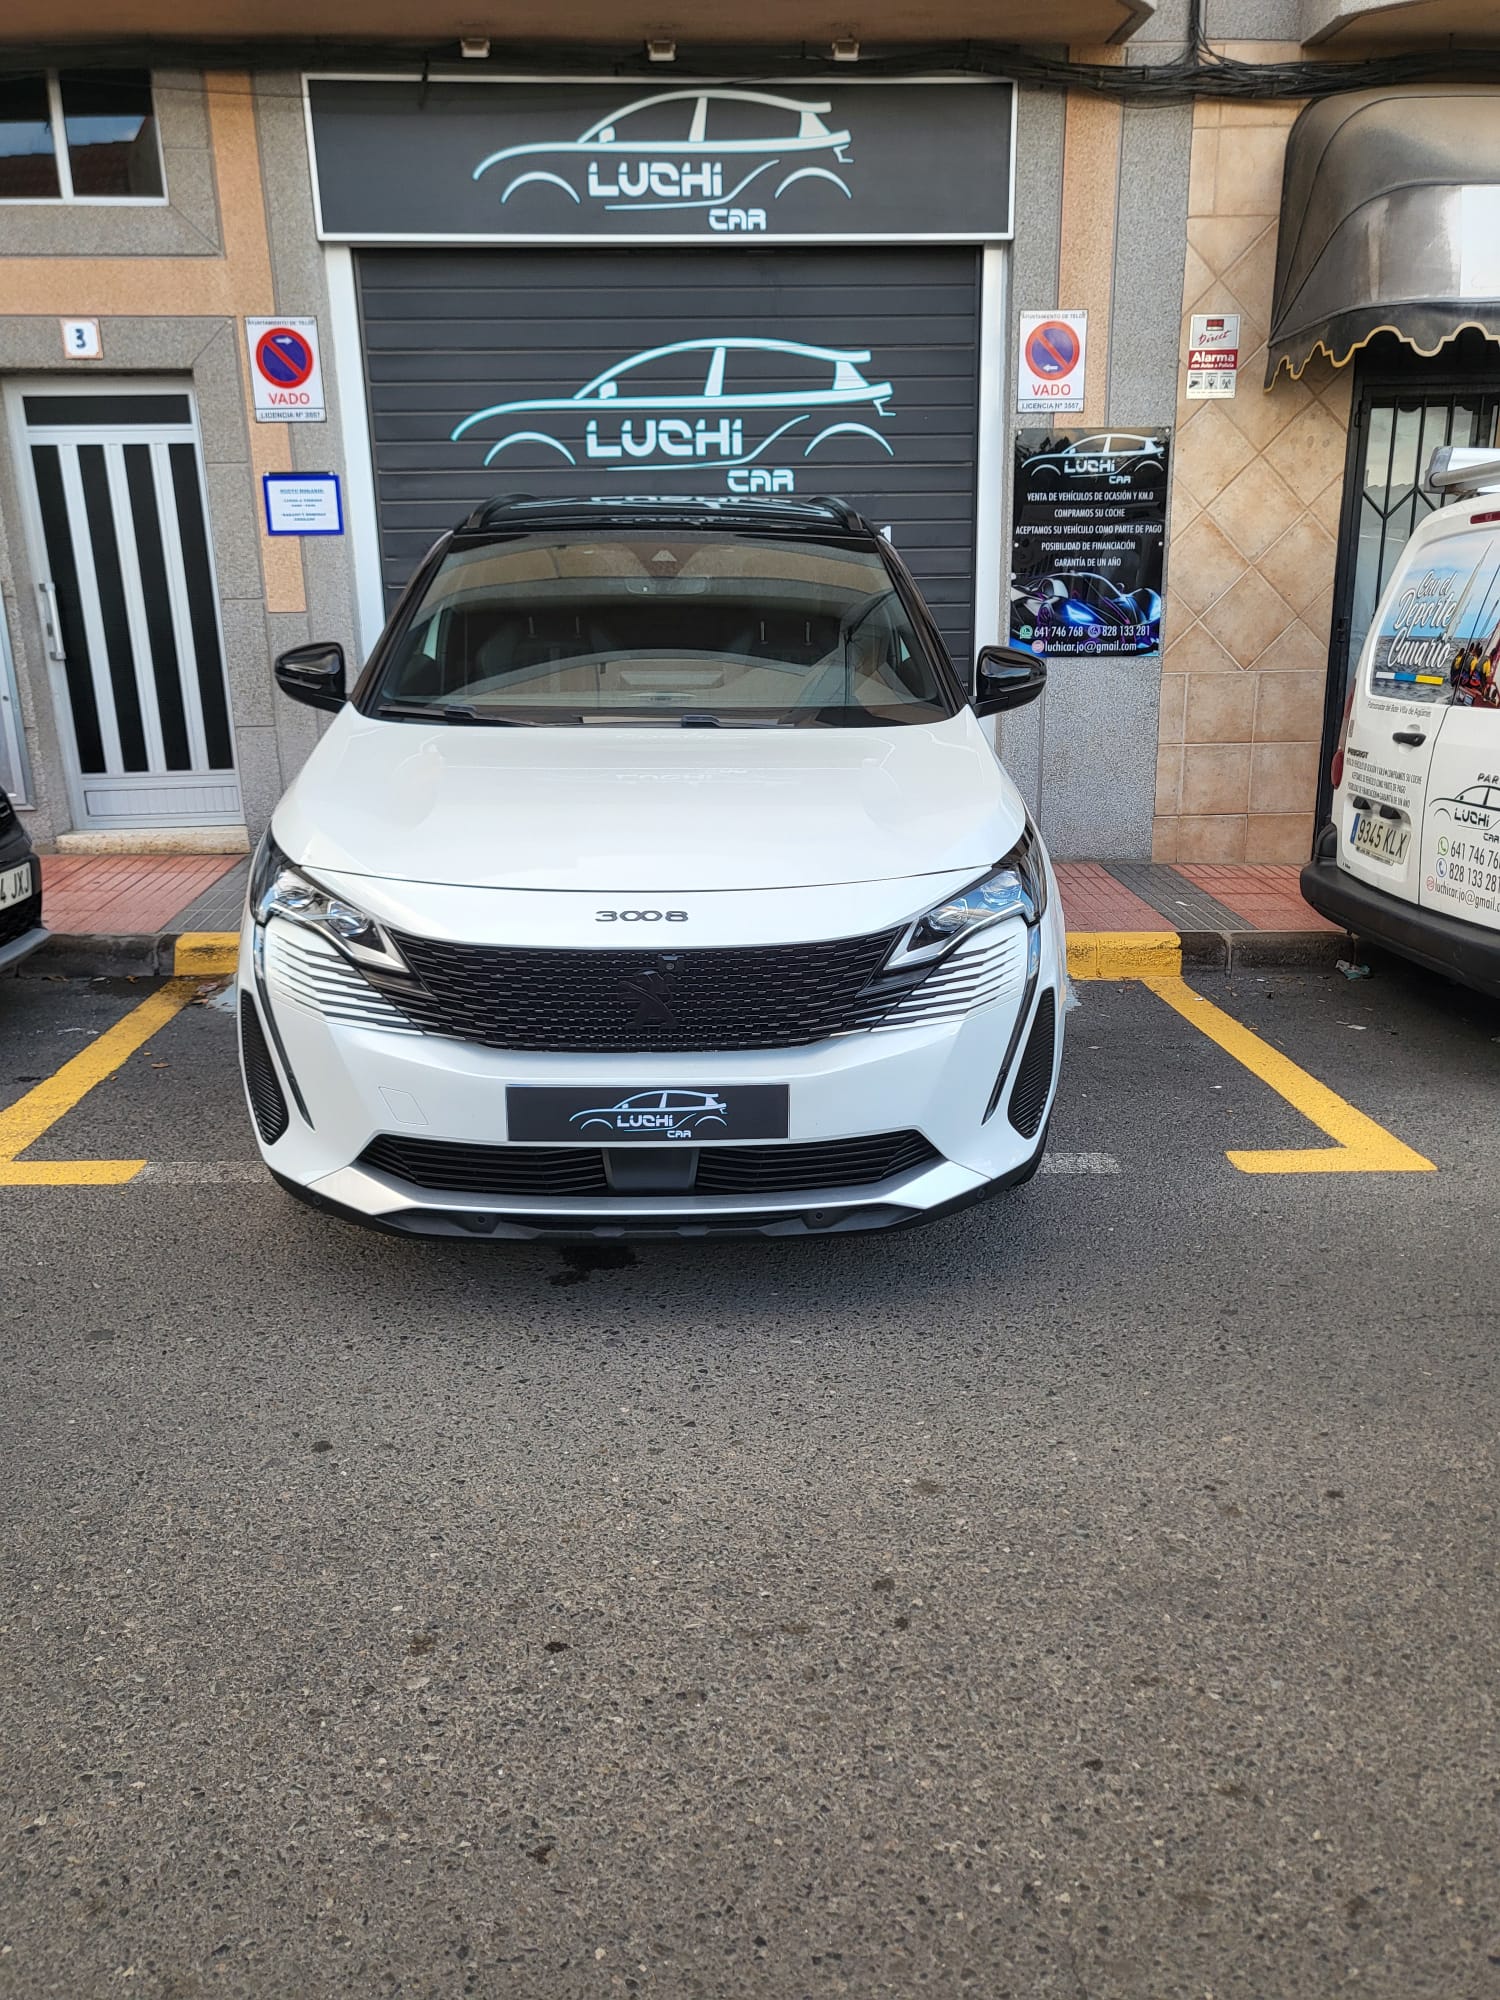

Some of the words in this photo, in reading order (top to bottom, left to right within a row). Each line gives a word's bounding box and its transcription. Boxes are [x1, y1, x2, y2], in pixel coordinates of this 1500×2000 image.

[587, 161, 722, 197] LUCHI
[708, 208, 767, 231] CAR
[75, 328, 86, 349] 3
[1198, 329, 1232, 346] Direct
[1191, 351, 1235, 363] Alarma
[1031, 383, 1071, 396] VADO
[268, 392, 311, 405] VADO
[1021, 402, 1055, 410] LICENCIA
[260, 411, 293, 419] LICENCIA
[586, 418, 743, 457] LUCHI
[1064, 459, 1116, 473] LUCHI
[727, 468, 794, 492] CAR
[1108, 475, 1132, 484] CAR
[1027, 492, 1047, 502] VENTA
[1048, 492, 1058, 502] DE
[1059, 490, 1093, 502] VEHÍCULOS
[1094, 491, 1103, 501] DE
[1104, 489, 1132, 501] OCASIÓN
[1133, 491, 1138, 501] Y
[1054, 508, 1094, 518] COMPRAMOS
[1095, 508, 1104, 518] SU
[1104, 508, 1126, 518] COCHE
[1015, 525, 1052, 535] ACEPTAMOS
[1053, 525, 1062, 535] SU
[1063, 523, 1094, 535] VEHÍCULO
[1095, 525, 1114, 534] COMO
[1114, 524, 1134, 534] PARTE
[1135, 524, 1144, 534] DE
[1145, 524, 1163, 533] PAGO
[1041, 541, 1081, 551] POSIBILIDAD
[1082, 541, 1091, 551] DE
[1092, 539, 1136, 551] FINANCIACIÓN
[1054, 556, 1086, 567] GARANTÍA
[1087, 557, 1096, 567] DE
[1096, 557, 1107, 567] UN
[1107, 556, 1122, 567] AÑO
[1416, 569, 1440, 598] Con
[1439, 570, 1458, 596] el
[1393, 588, 1457, 638] Deporte
[1034, 625, 1049, 638] 641
[1051, 625, 1067, 637] 746
[1068, 625, 1084, 637] 768
[1102, 625, 1118, 637] 828
[1120, 625, 1134, 637] 133
[1135, 625, 1150, 637] 281
[1044, 640, 1137, 654] luchicar.jo@gmail.com
[1387, 626, 1451, 668] Canario
[1454, 807, 1490, 828] LUCHI
[1357, 819, 1384, 849] 9345
[1382, 827, 1408, 859] KLX
[1483, 832, 1500, 845] CAR
[1451, 840, 1466, 861] 641
[1468, 844, 1485, 866] 746
[1449, 862, 1465, 883] 828
[1467, 867, 1483, 889] 133
[11, 866, 30, 900] JXJ
[594, 910, 689, 922] 3008
[616, 1114, 675, 1128] LUCHI
[666, 1129, 692, 1139] CAR
